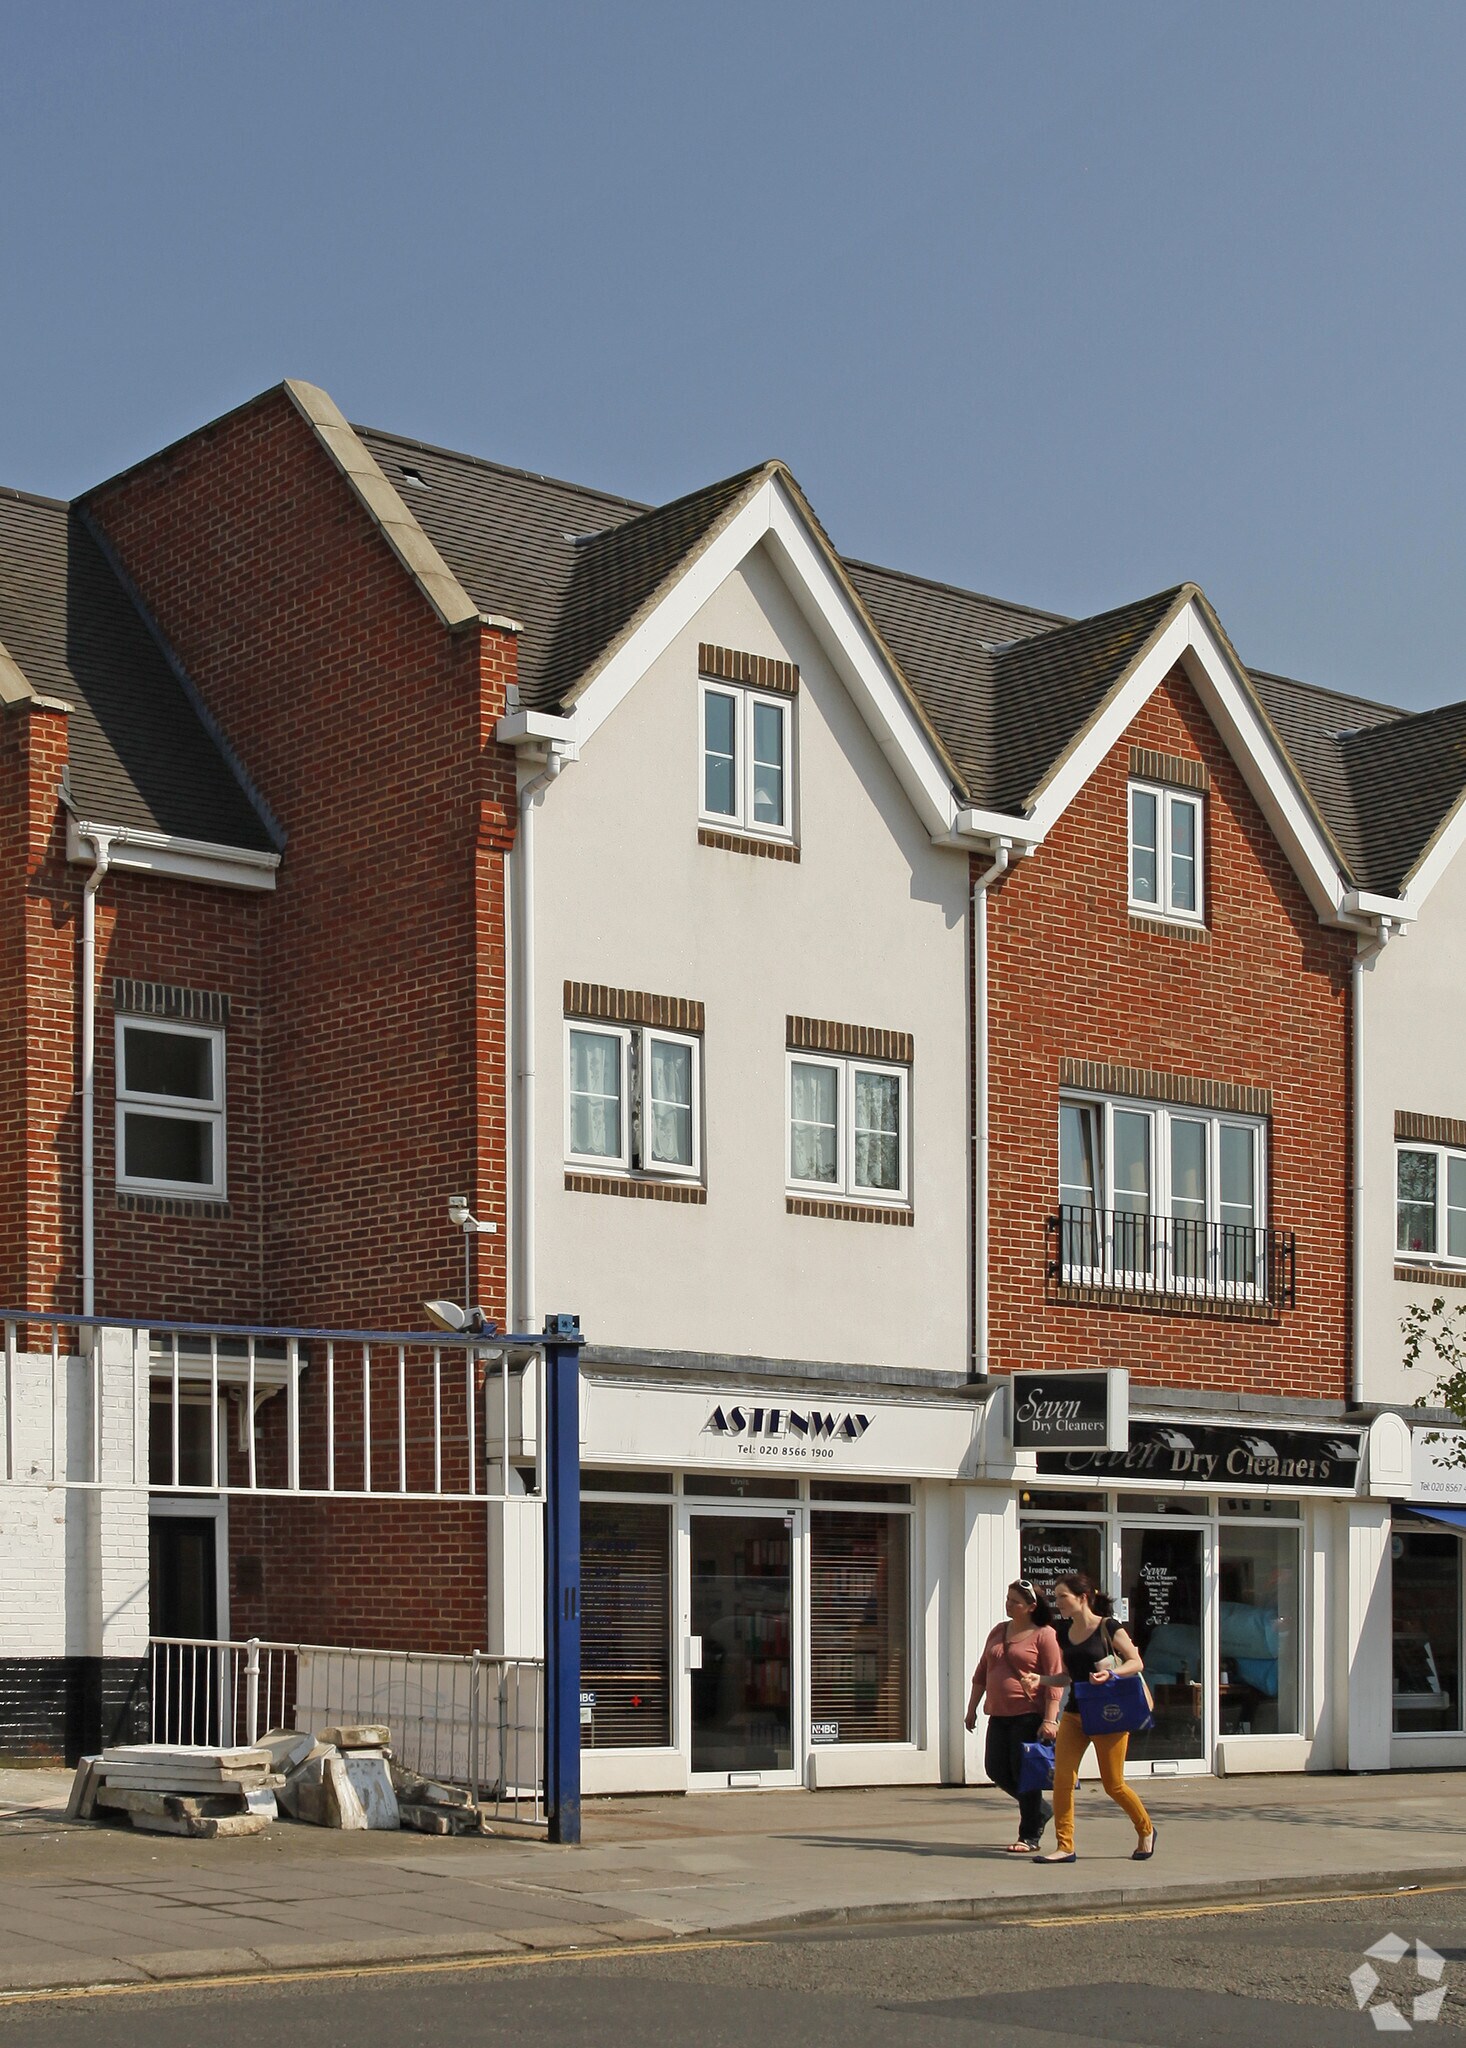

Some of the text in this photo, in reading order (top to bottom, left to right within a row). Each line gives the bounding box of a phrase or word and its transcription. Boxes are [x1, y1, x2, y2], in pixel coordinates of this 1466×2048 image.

[1016, 1388, 1081, 1423] Seven
[702, 1403, 877, 1439] ASTENWAY
[1031, 1419, 1105, 1435] Dry Cleaners
[737, 1444, 834, 1458] Tel: 020 8566 1900
[1169, 1448, 1219, 1480] Dry
[1226, 1447, 1330, 1479] Cleaners
[1430, 1482, 1444, 1492] 020
[1445, 1482, 1462, 1493] 8567
[1157, 1502, 1166, 1513] 2
[1028, 1543, 1072, 1555] Dry Cleaning
[1028, 1555, 1070, 1564] Shirt Service
[1028, 1565, 1078, 1576] Ironing Service
